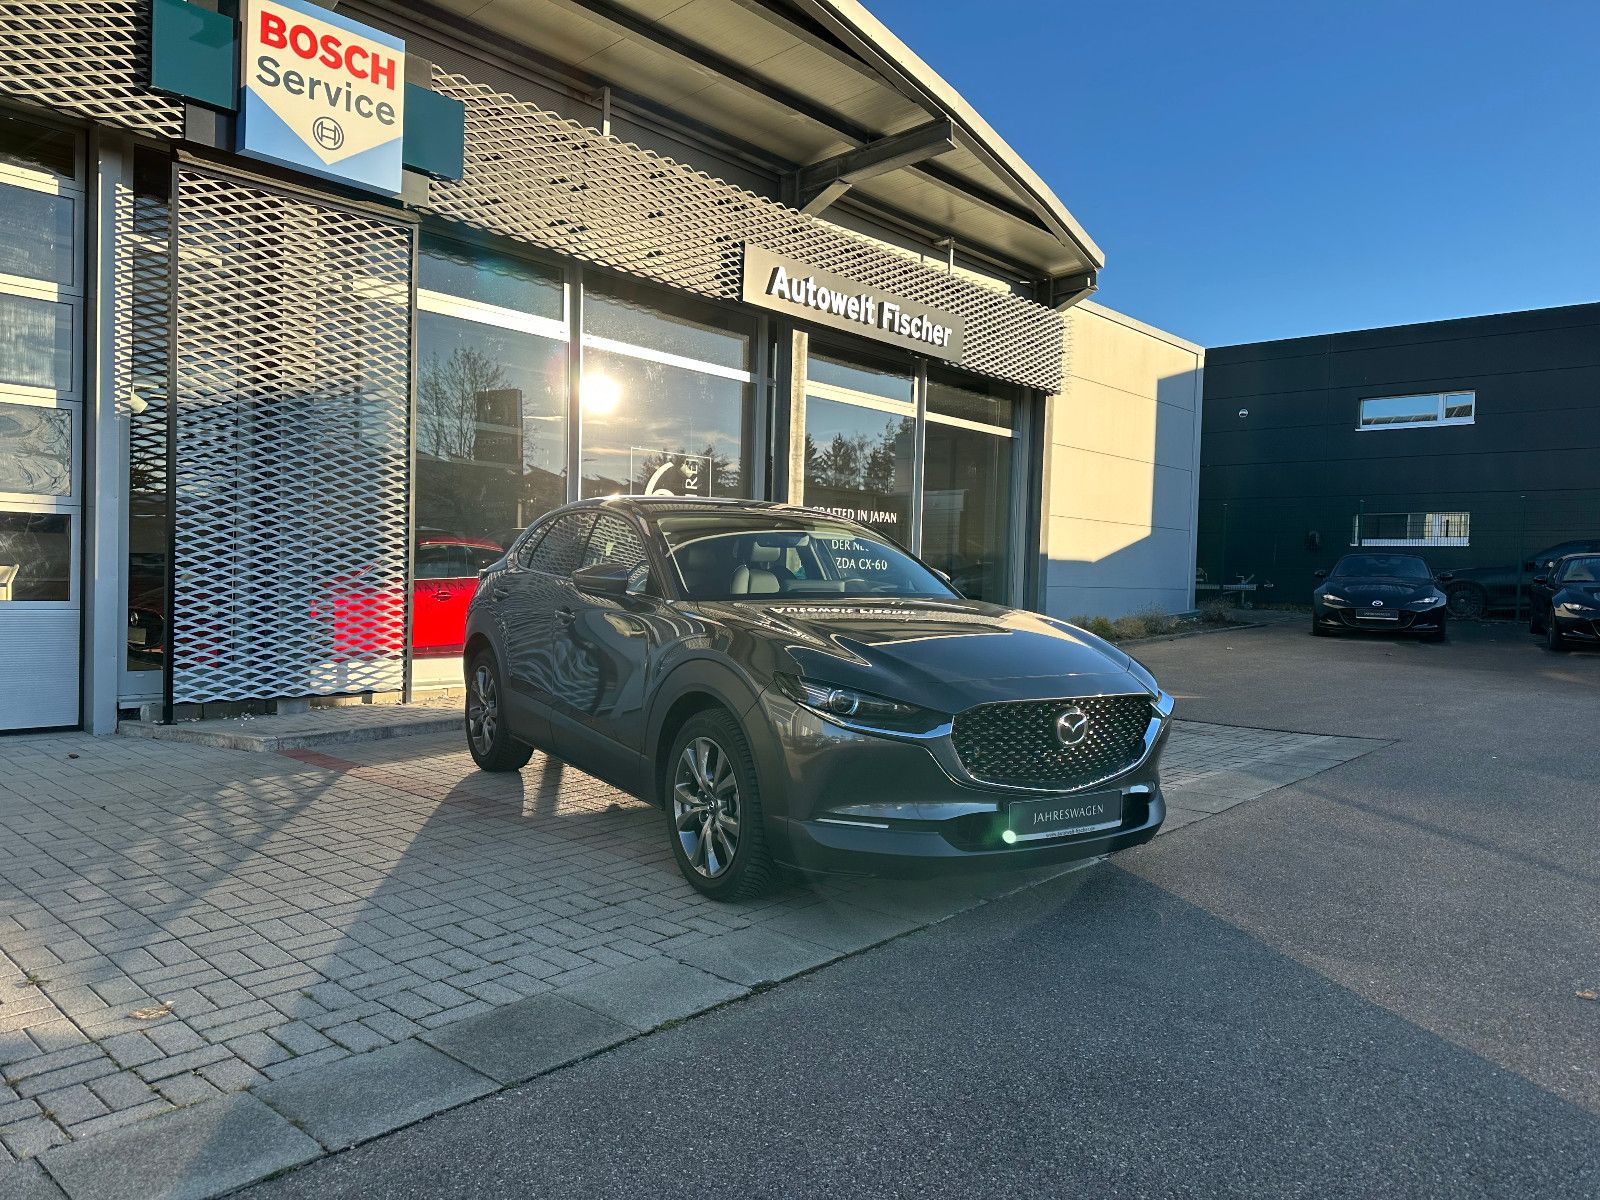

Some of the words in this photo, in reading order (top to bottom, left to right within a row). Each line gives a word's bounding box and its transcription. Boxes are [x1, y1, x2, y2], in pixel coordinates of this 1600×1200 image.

[260, 10, 395, 91] BOSCH
[256, 55, 396, 126] Service
[768, 266, 876, 325] Autowelt
[880, 301, 952, 347] Fischer
[858, 509, 868, 521] IN
[869, 510, 897, 523] JAPAN
[831, 539, 850, 550] DER
[858, 558, 888, 570] CX-60
[1033, 804, 1104, 825] JAHRESWAGEN
